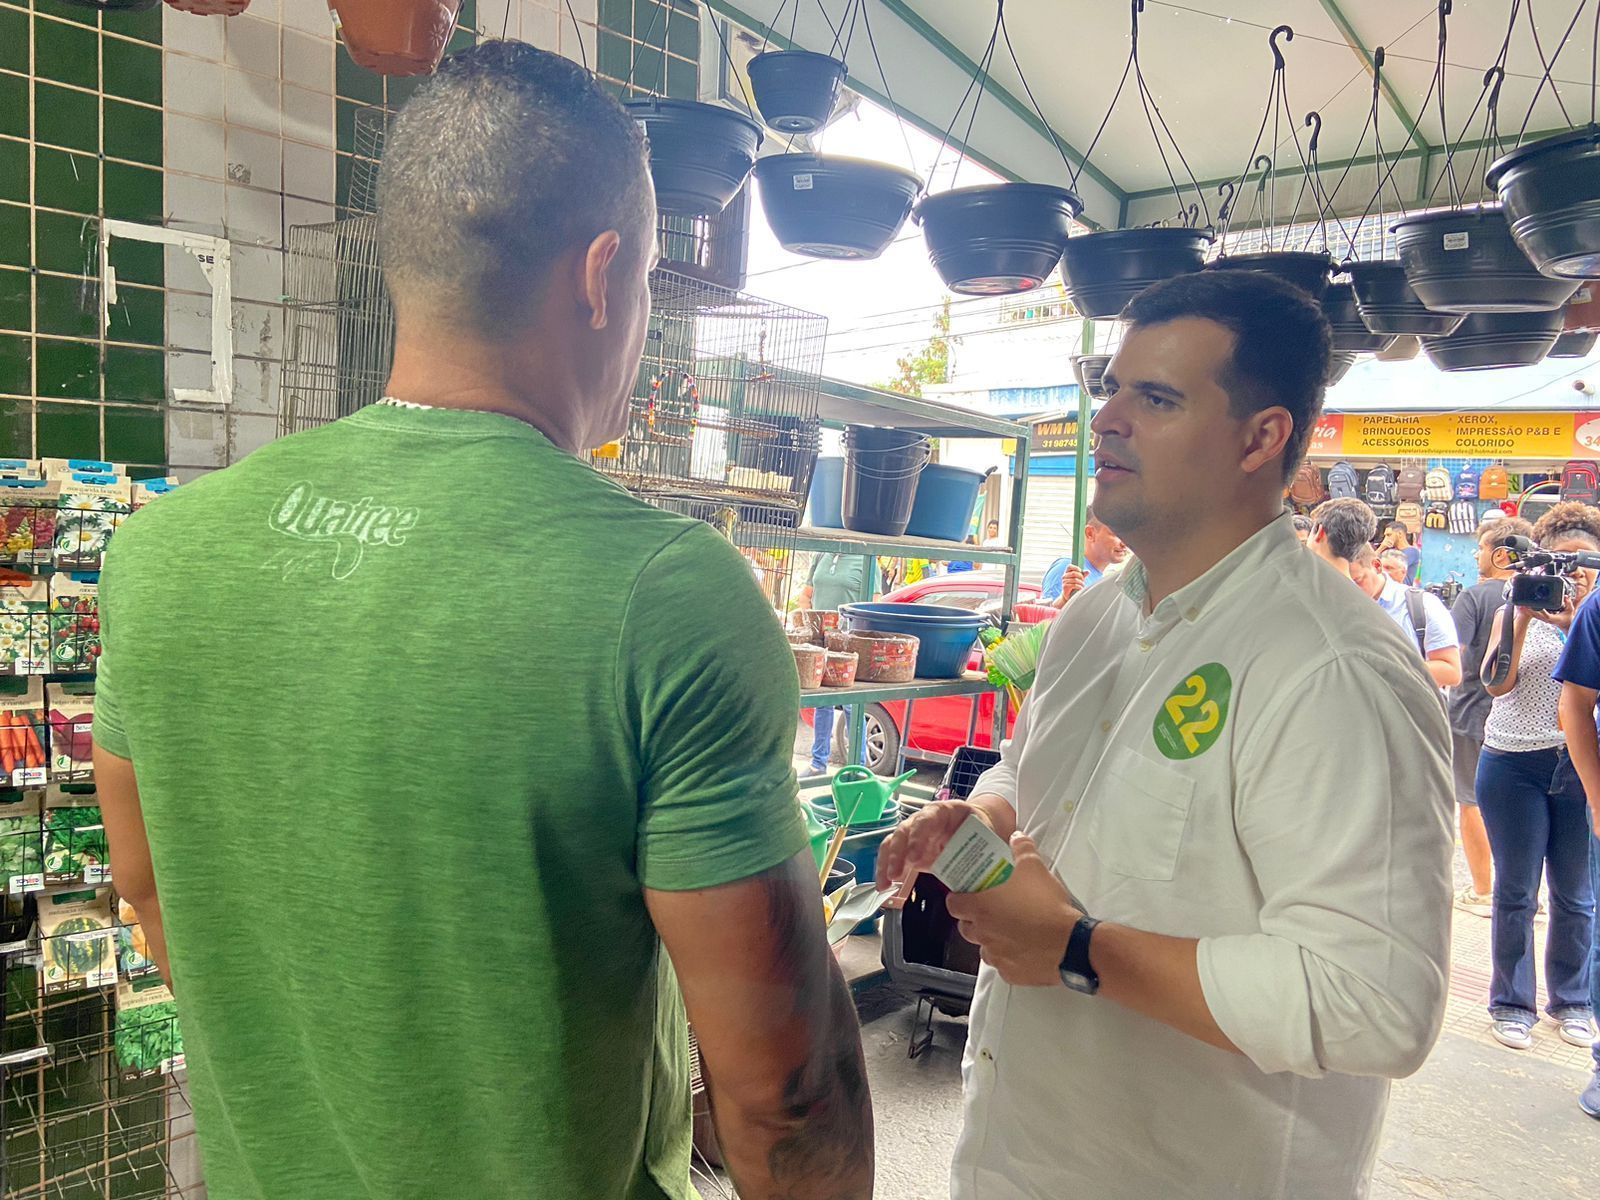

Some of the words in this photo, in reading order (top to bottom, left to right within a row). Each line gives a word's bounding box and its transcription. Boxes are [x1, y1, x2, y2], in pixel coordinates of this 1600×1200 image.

[1363, 416, 1420, 424] PAPELARIA
[1457, 415, 1498, 425] XEROX,
[1037, 422, 1063, 435] WM
[1313, 423, 1337, 440] ria
[1362, 427, 1431, 436] BRINQUEDOS
[1456, 426, 1522, 436] IMPRESSÃO
[1526, 427, 1550, 436] P&B
[1553, 427, 1561, 436] E
[1362, 437, 1429, 447] ACESSÓRIOS
[1455, 438, 1515, 447] COLORIDO
[1164, 674, 1220, 754] 22
